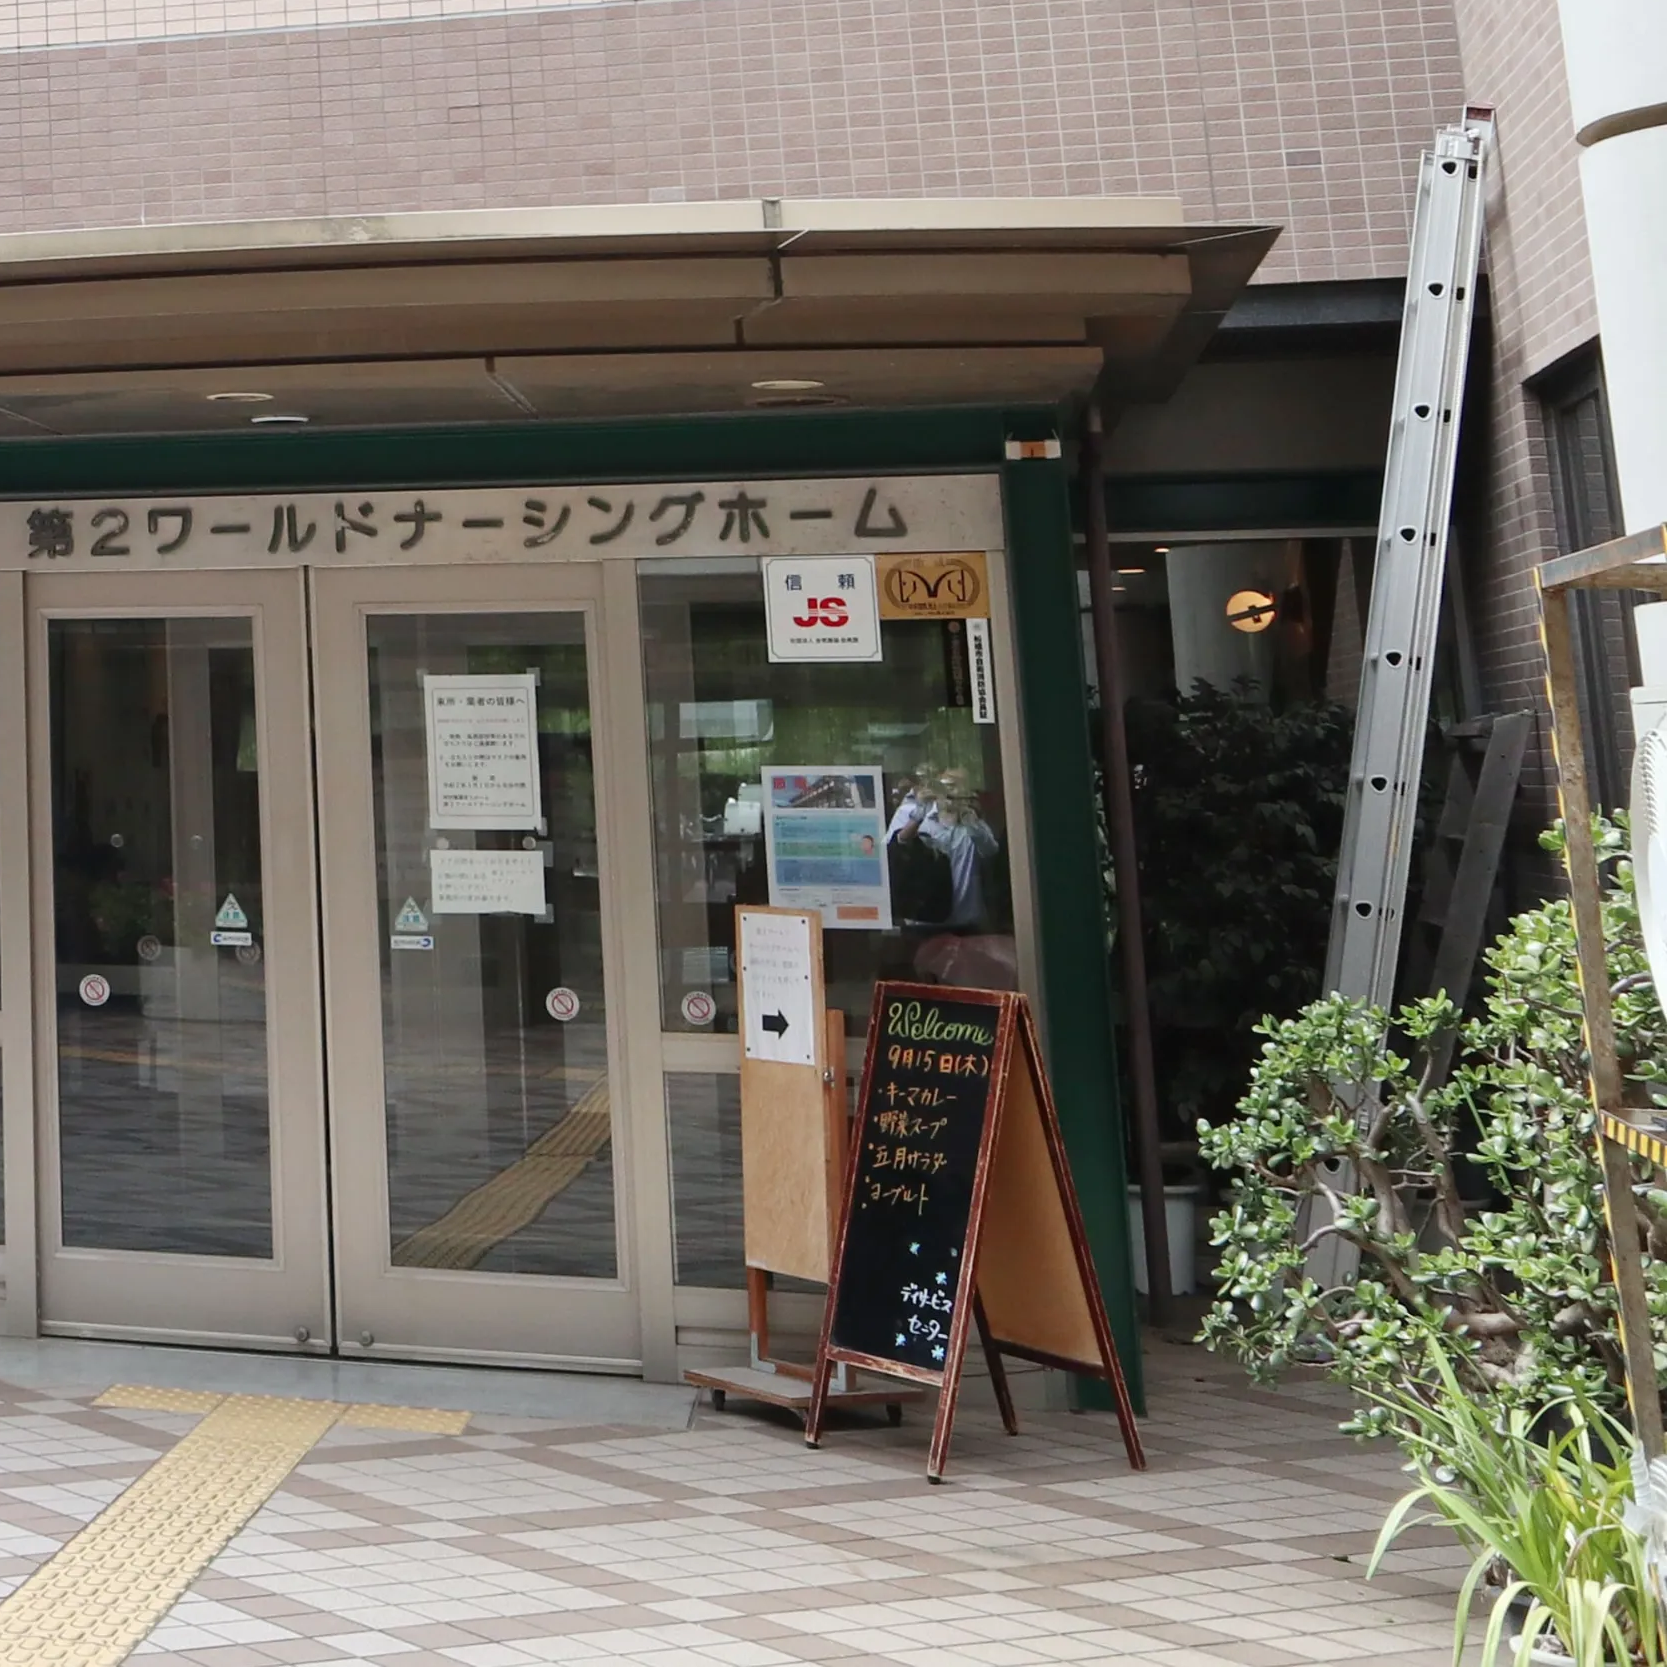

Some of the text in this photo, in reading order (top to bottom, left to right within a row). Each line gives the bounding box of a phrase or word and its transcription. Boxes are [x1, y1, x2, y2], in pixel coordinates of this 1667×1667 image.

[27, 487, 908, 560] 第2ワールドナーシングホーム
[793, 597, 849, 627] JS
[888, 1001, 994, 1046] Welcome
